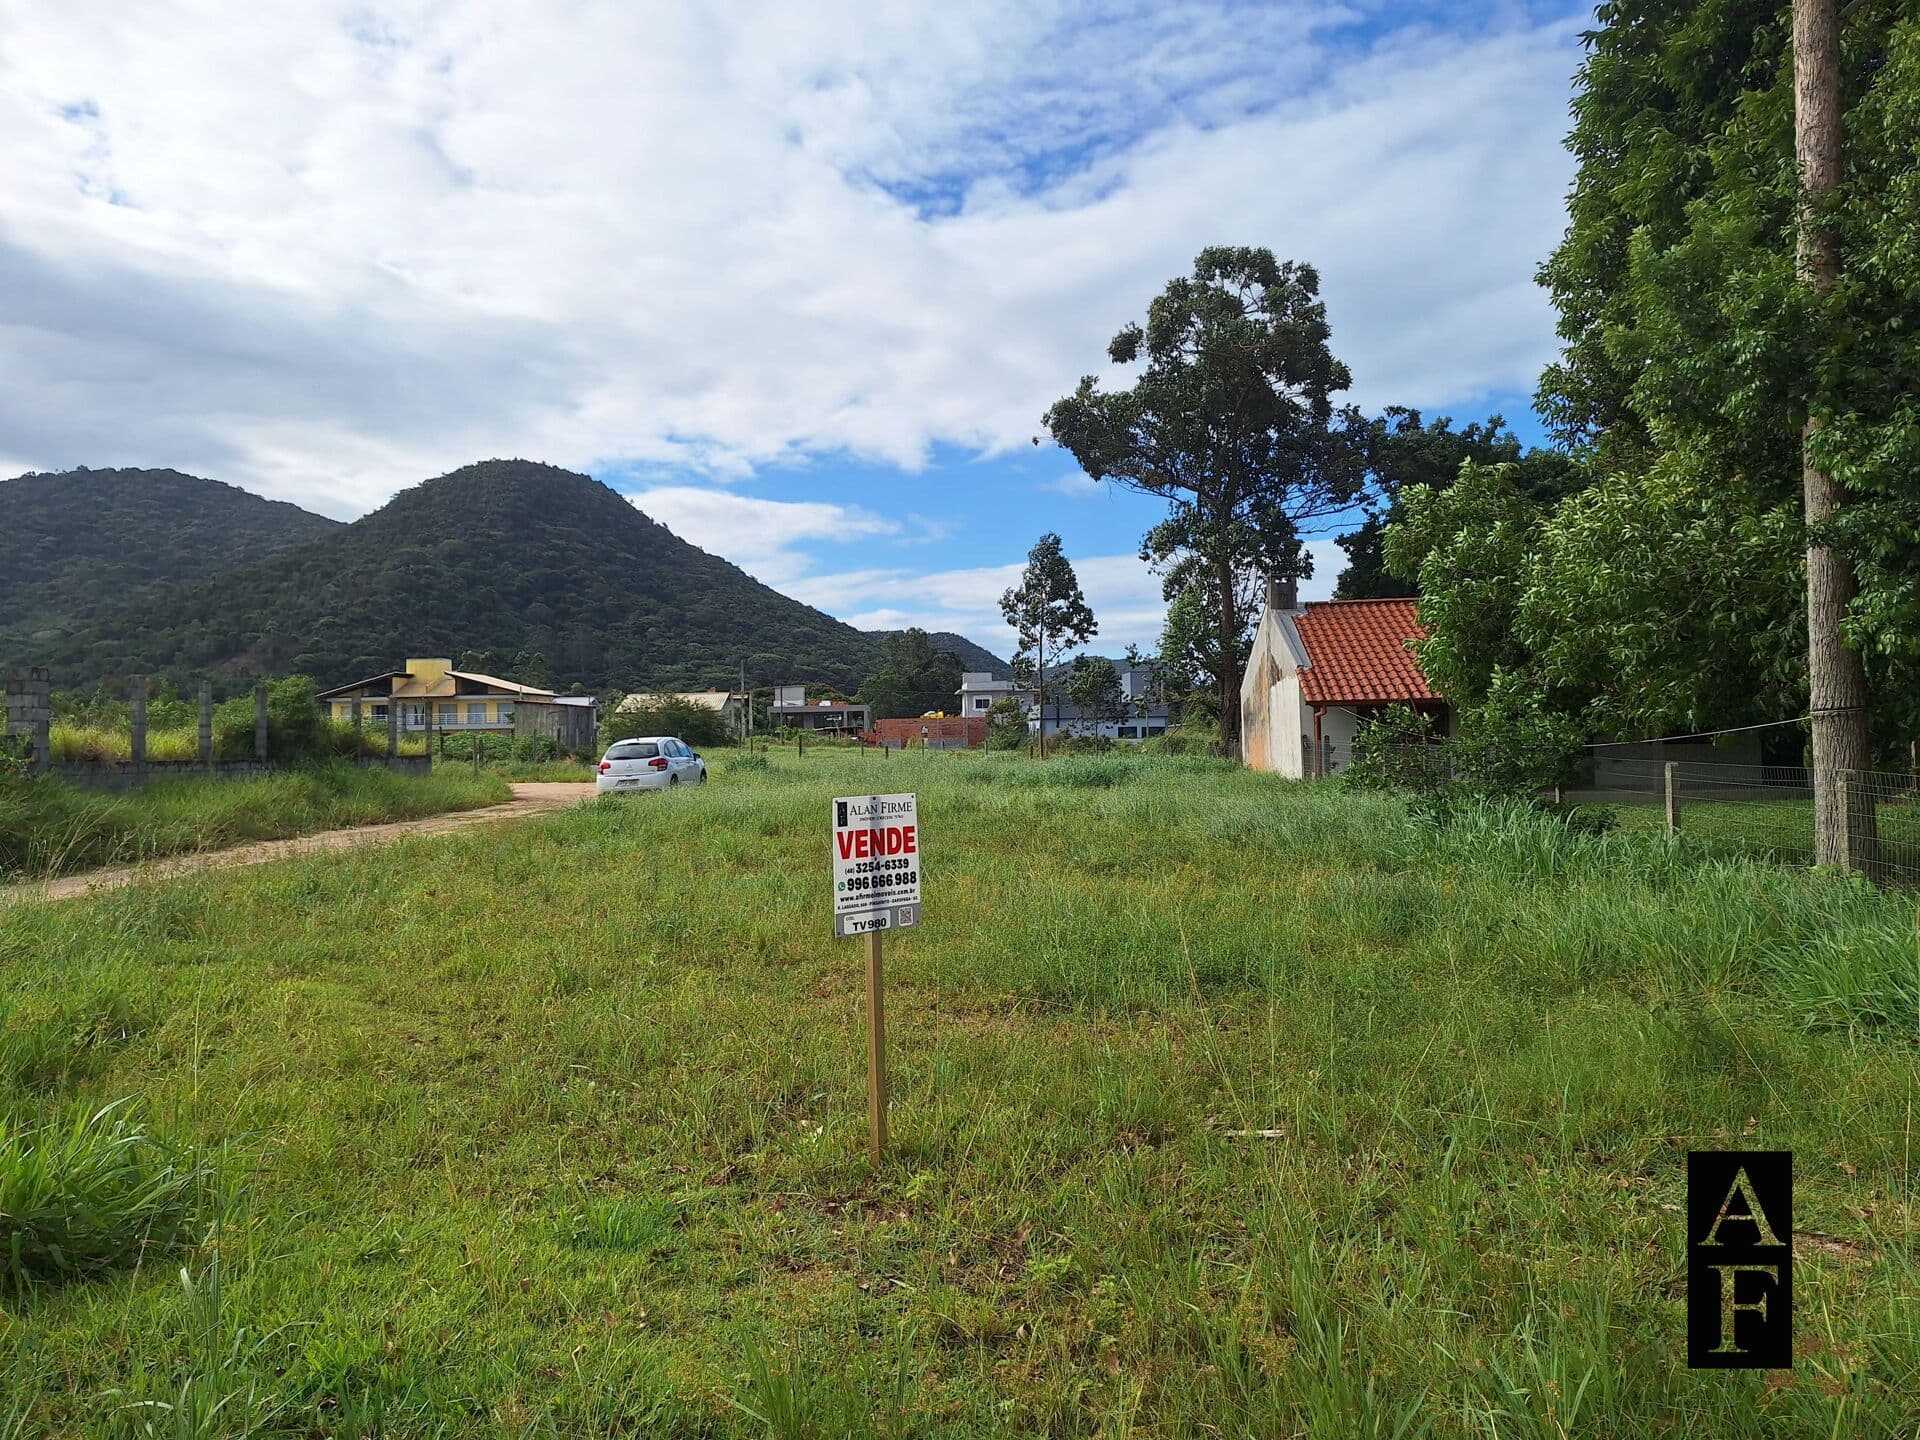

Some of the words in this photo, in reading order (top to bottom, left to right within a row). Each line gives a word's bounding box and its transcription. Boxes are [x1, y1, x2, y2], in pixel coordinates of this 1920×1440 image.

[850, 804, 878, 816] ALAN
[881, 801, 912, 814] FIRME
[837, 825, 916, 860] VENDE
[855, 858, 909, 874] 3254-6339
